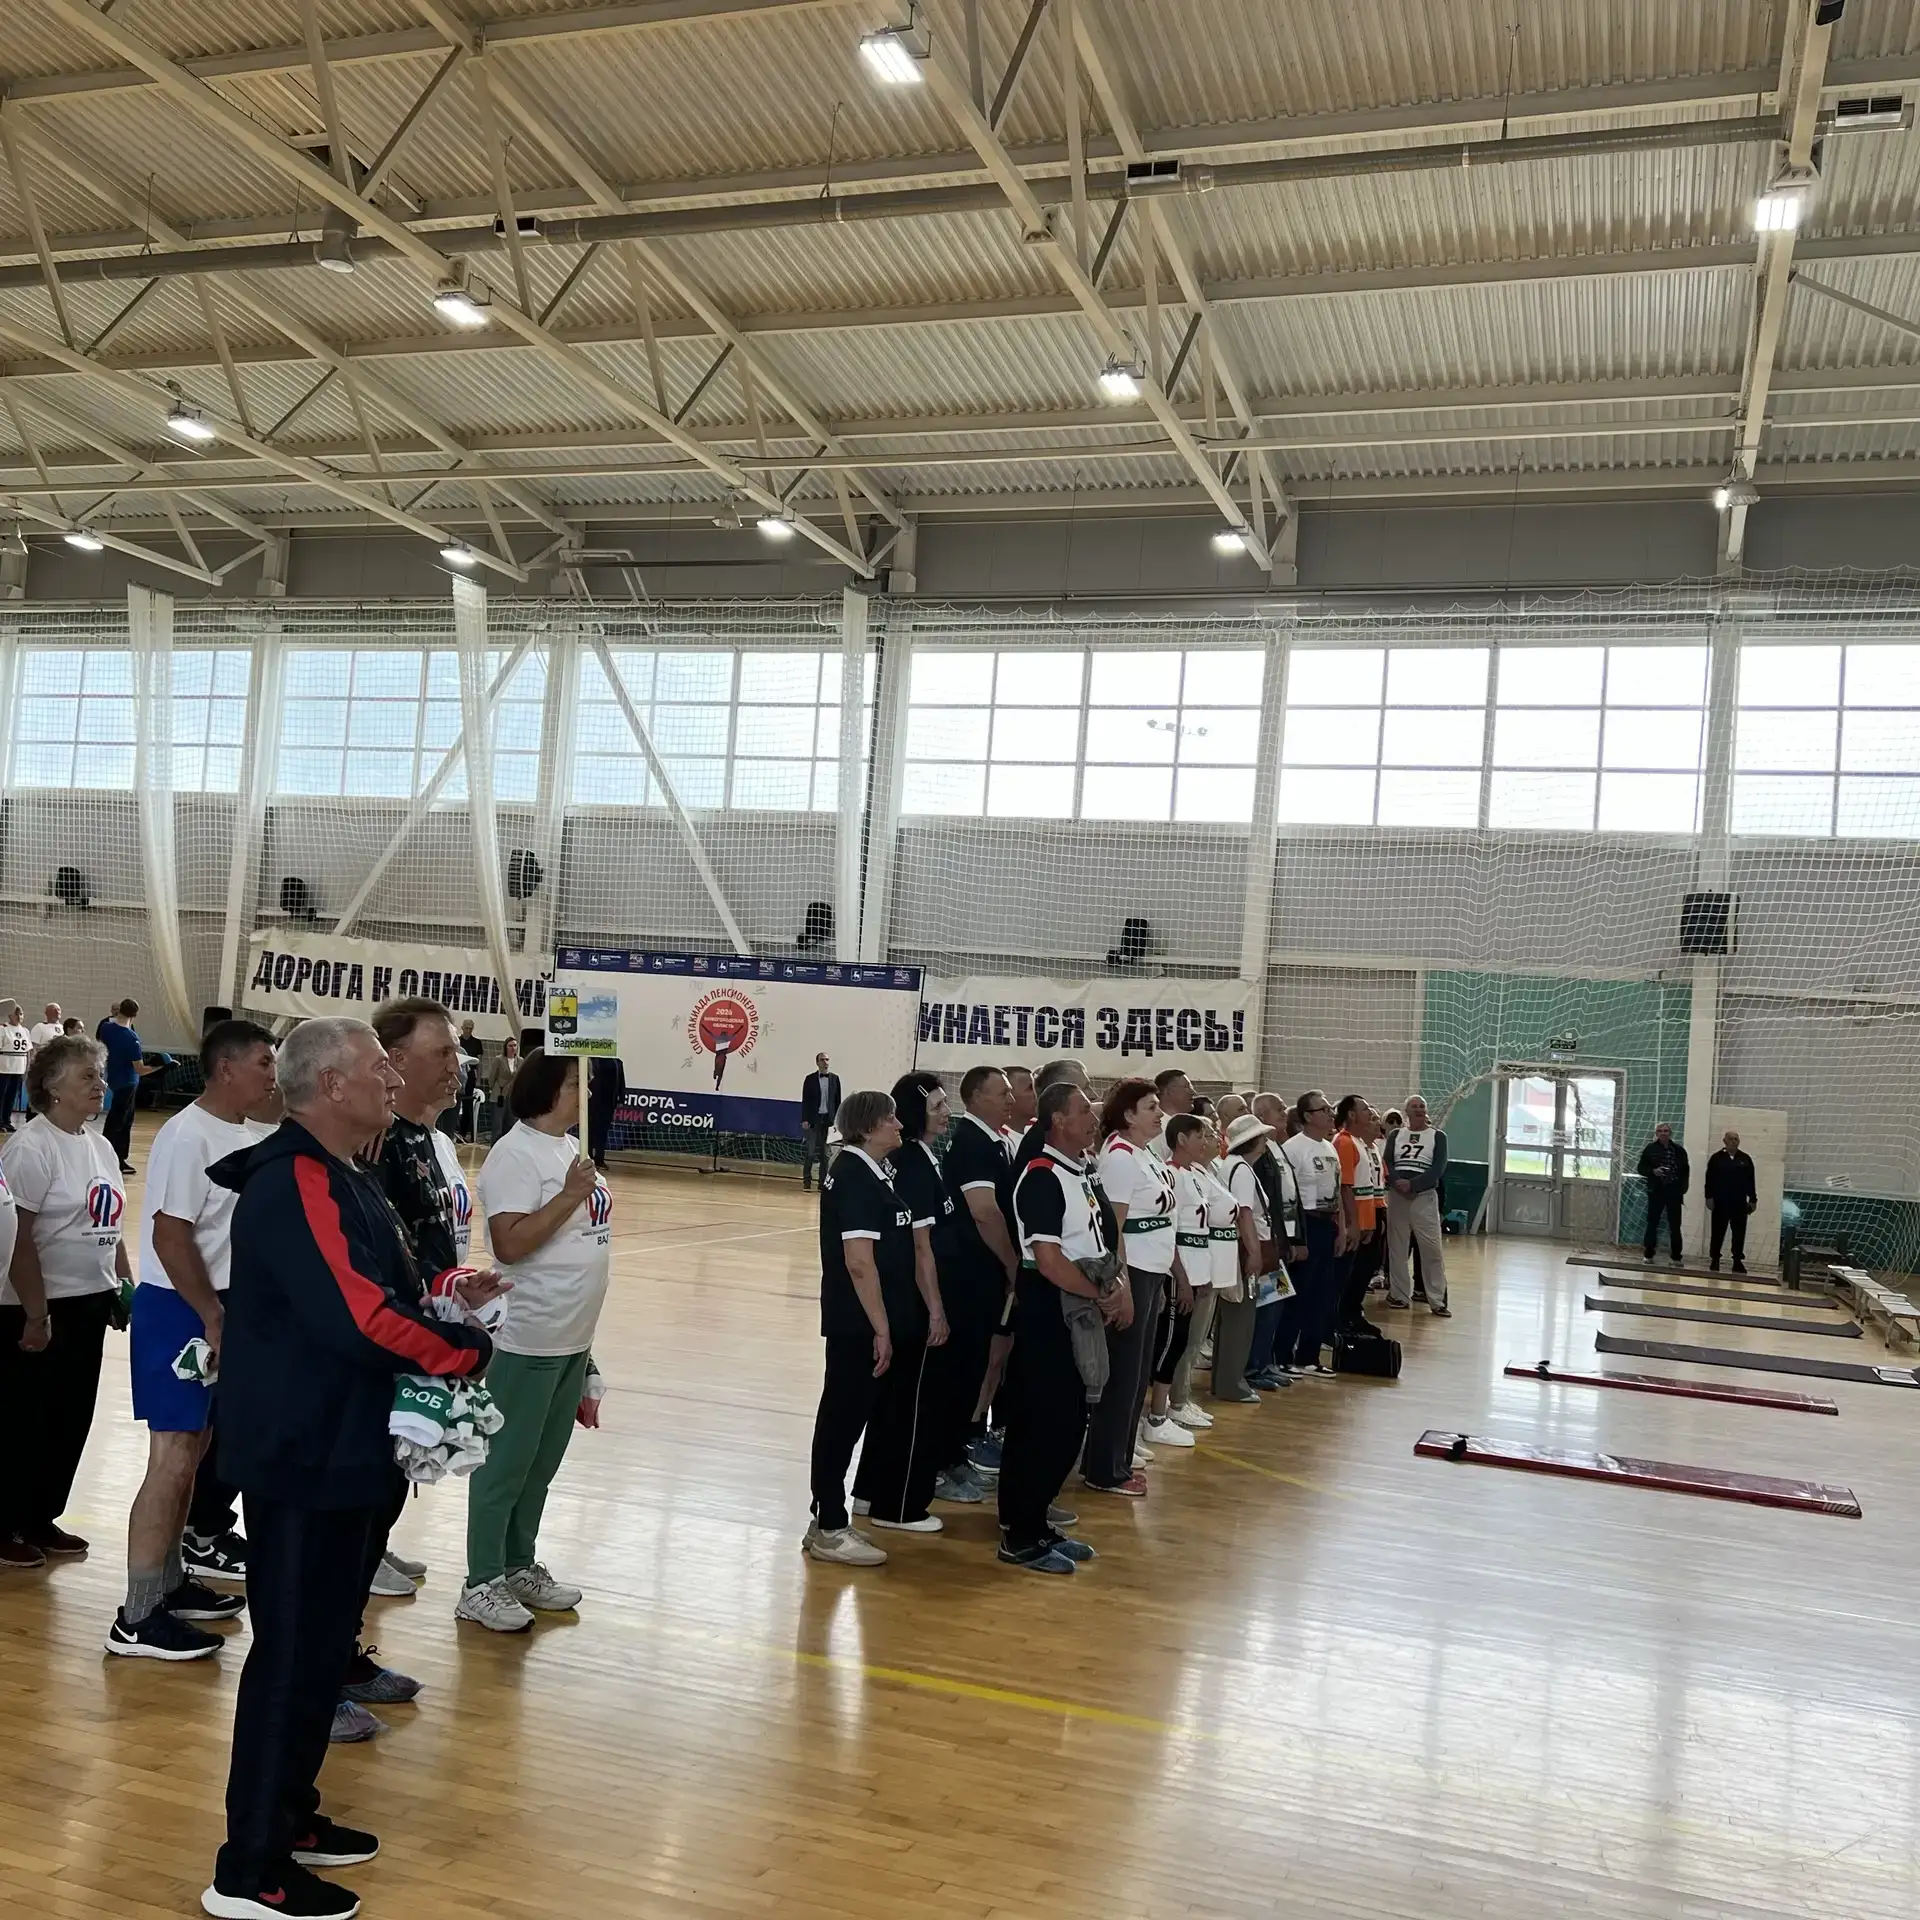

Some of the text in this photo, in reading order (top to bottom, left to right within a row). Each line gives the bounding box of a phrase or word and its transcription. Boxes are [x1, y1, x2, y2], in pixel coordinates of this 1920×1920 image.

[250, 950, 363, 1001] ДОРОГА
[371, 965, 393, 1003] К
[1095, 1007, 1245, 1057] ЗДЕСЬ!
[13, 1039, 27, 1051] 95
[553, 1037, 612, 1051] Вадский район
[647, 1111, 658, 1124] С
[661, 1113, 714, 1129] СОБОЙ
[1400, 1144, 1424, 1159] 27
